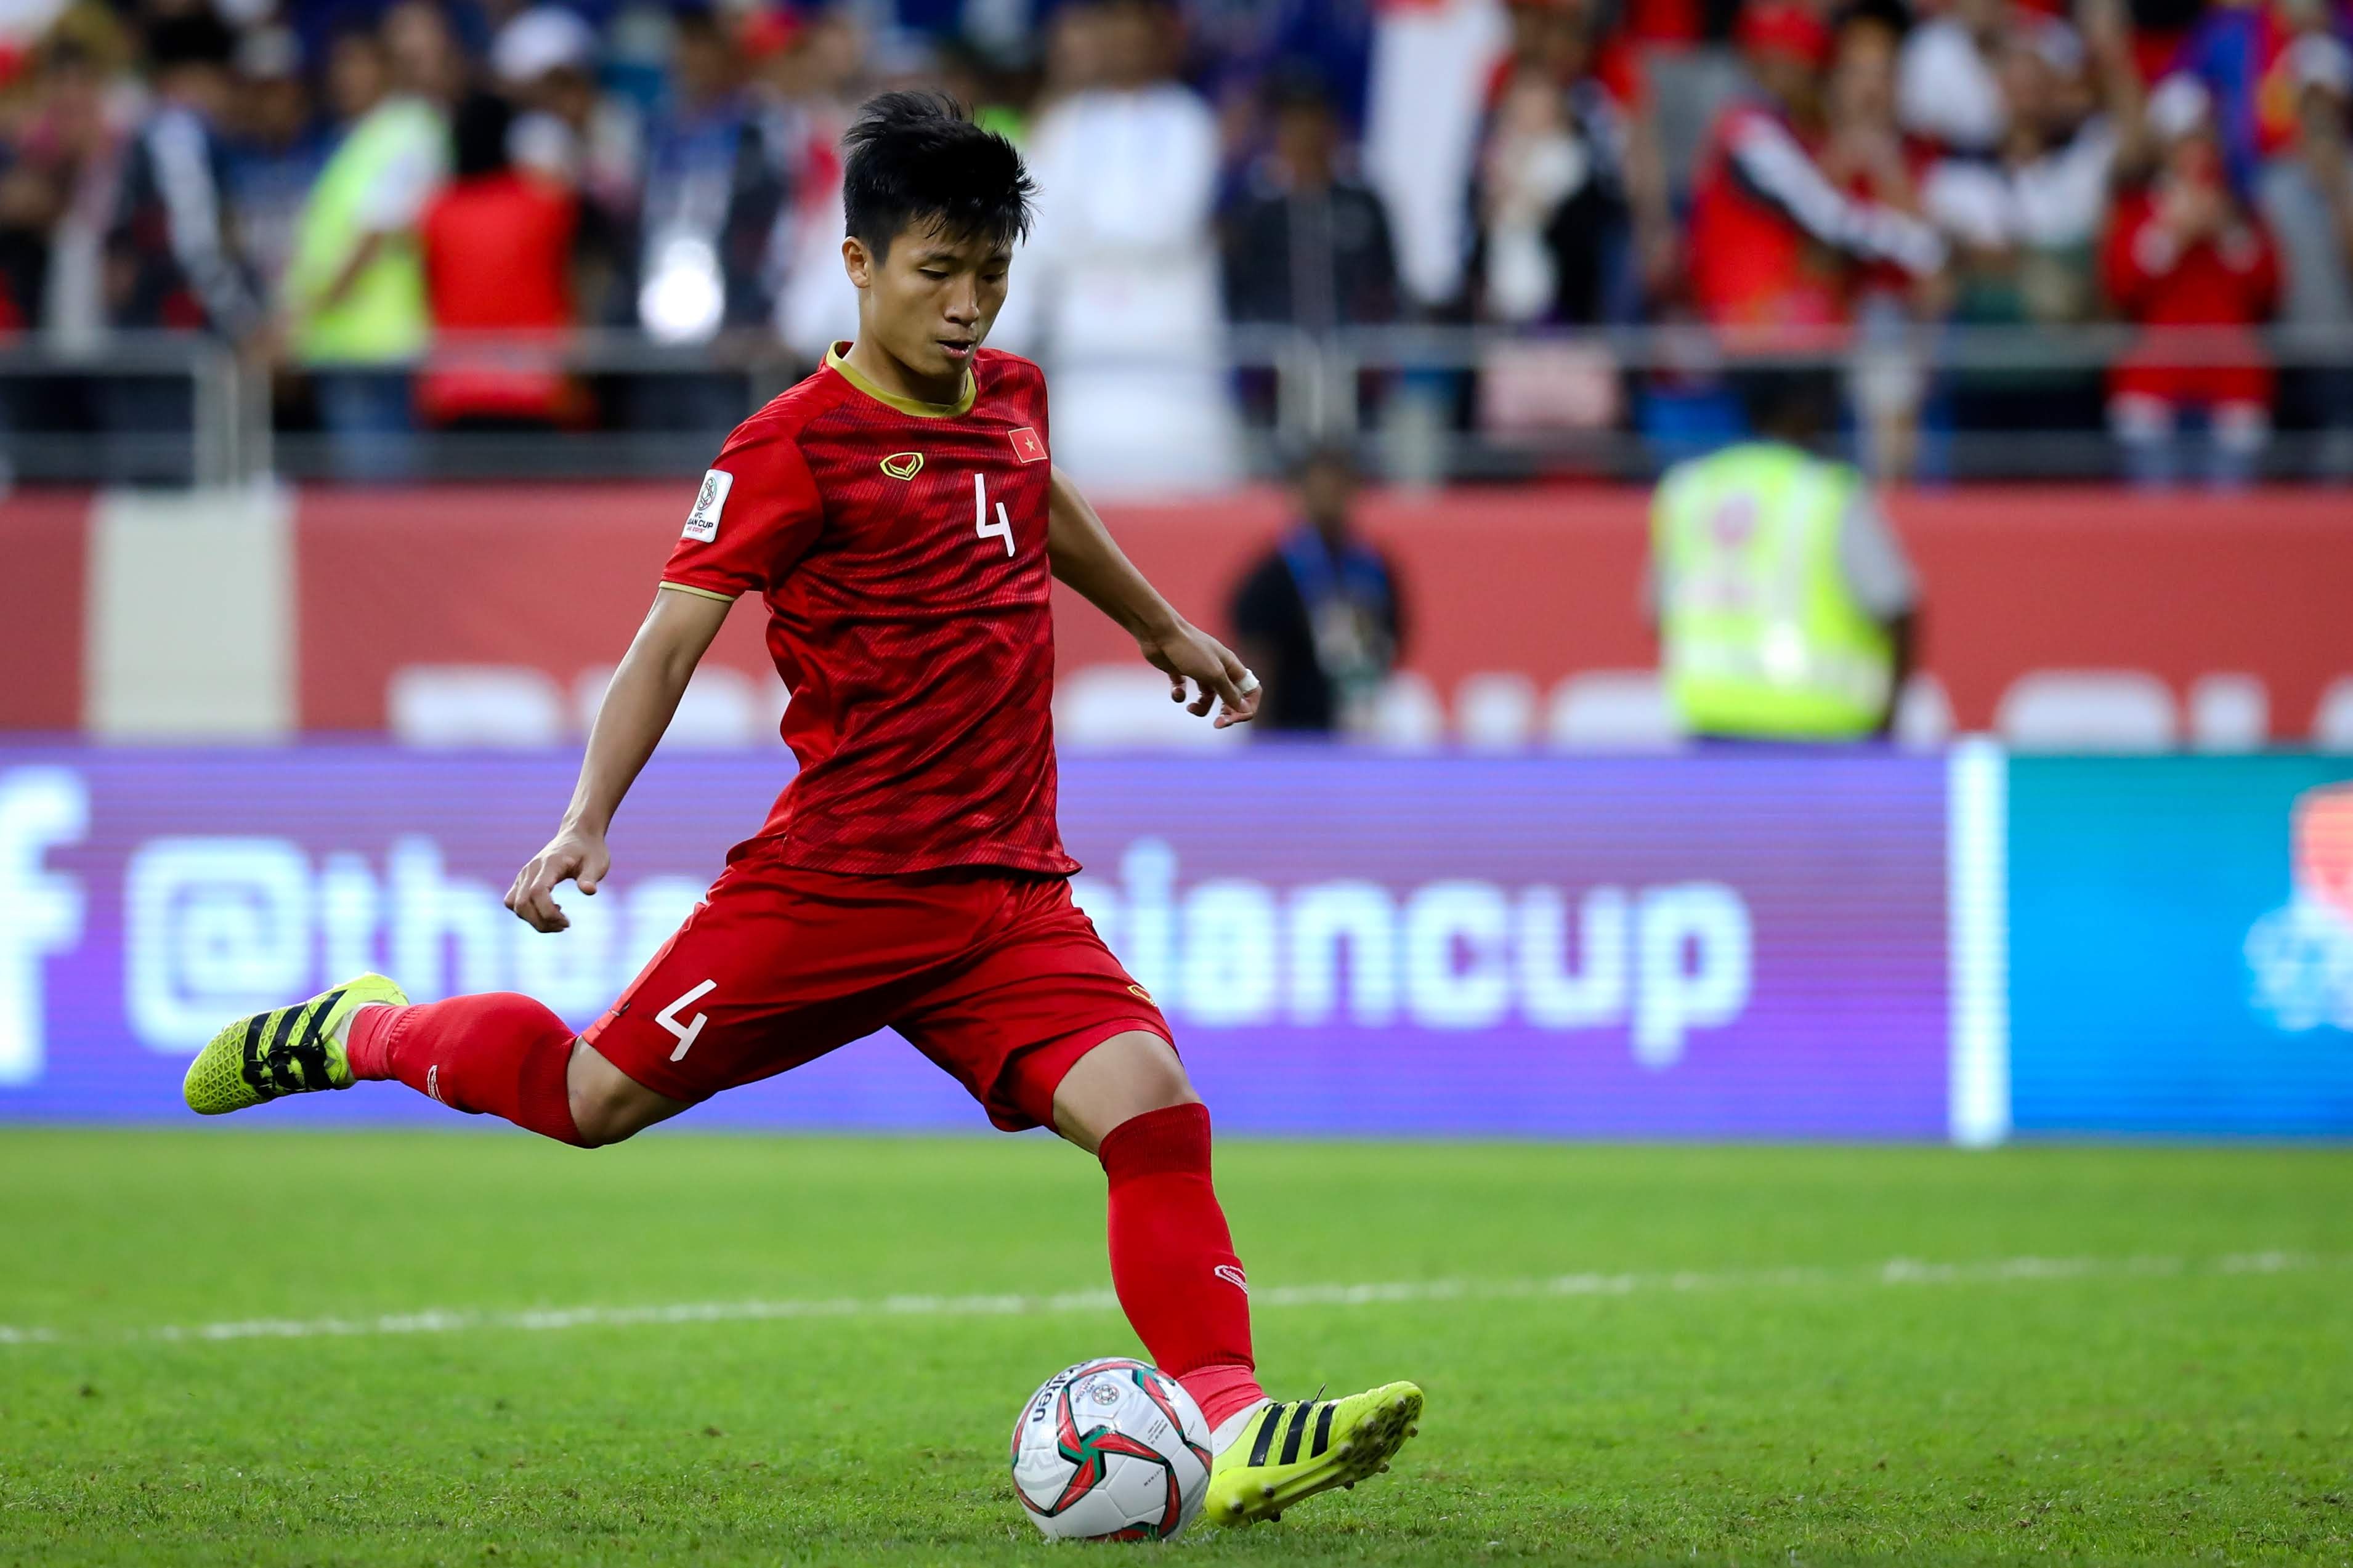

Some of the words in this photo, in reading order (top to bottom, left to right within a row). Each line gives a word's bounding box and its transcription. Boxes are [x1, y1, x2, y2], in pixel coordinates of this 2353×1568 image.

[698, 520, 713, 528] CUP
[974, 473, 1015, 557] 4
[655, 979, 718, 1062] 4
